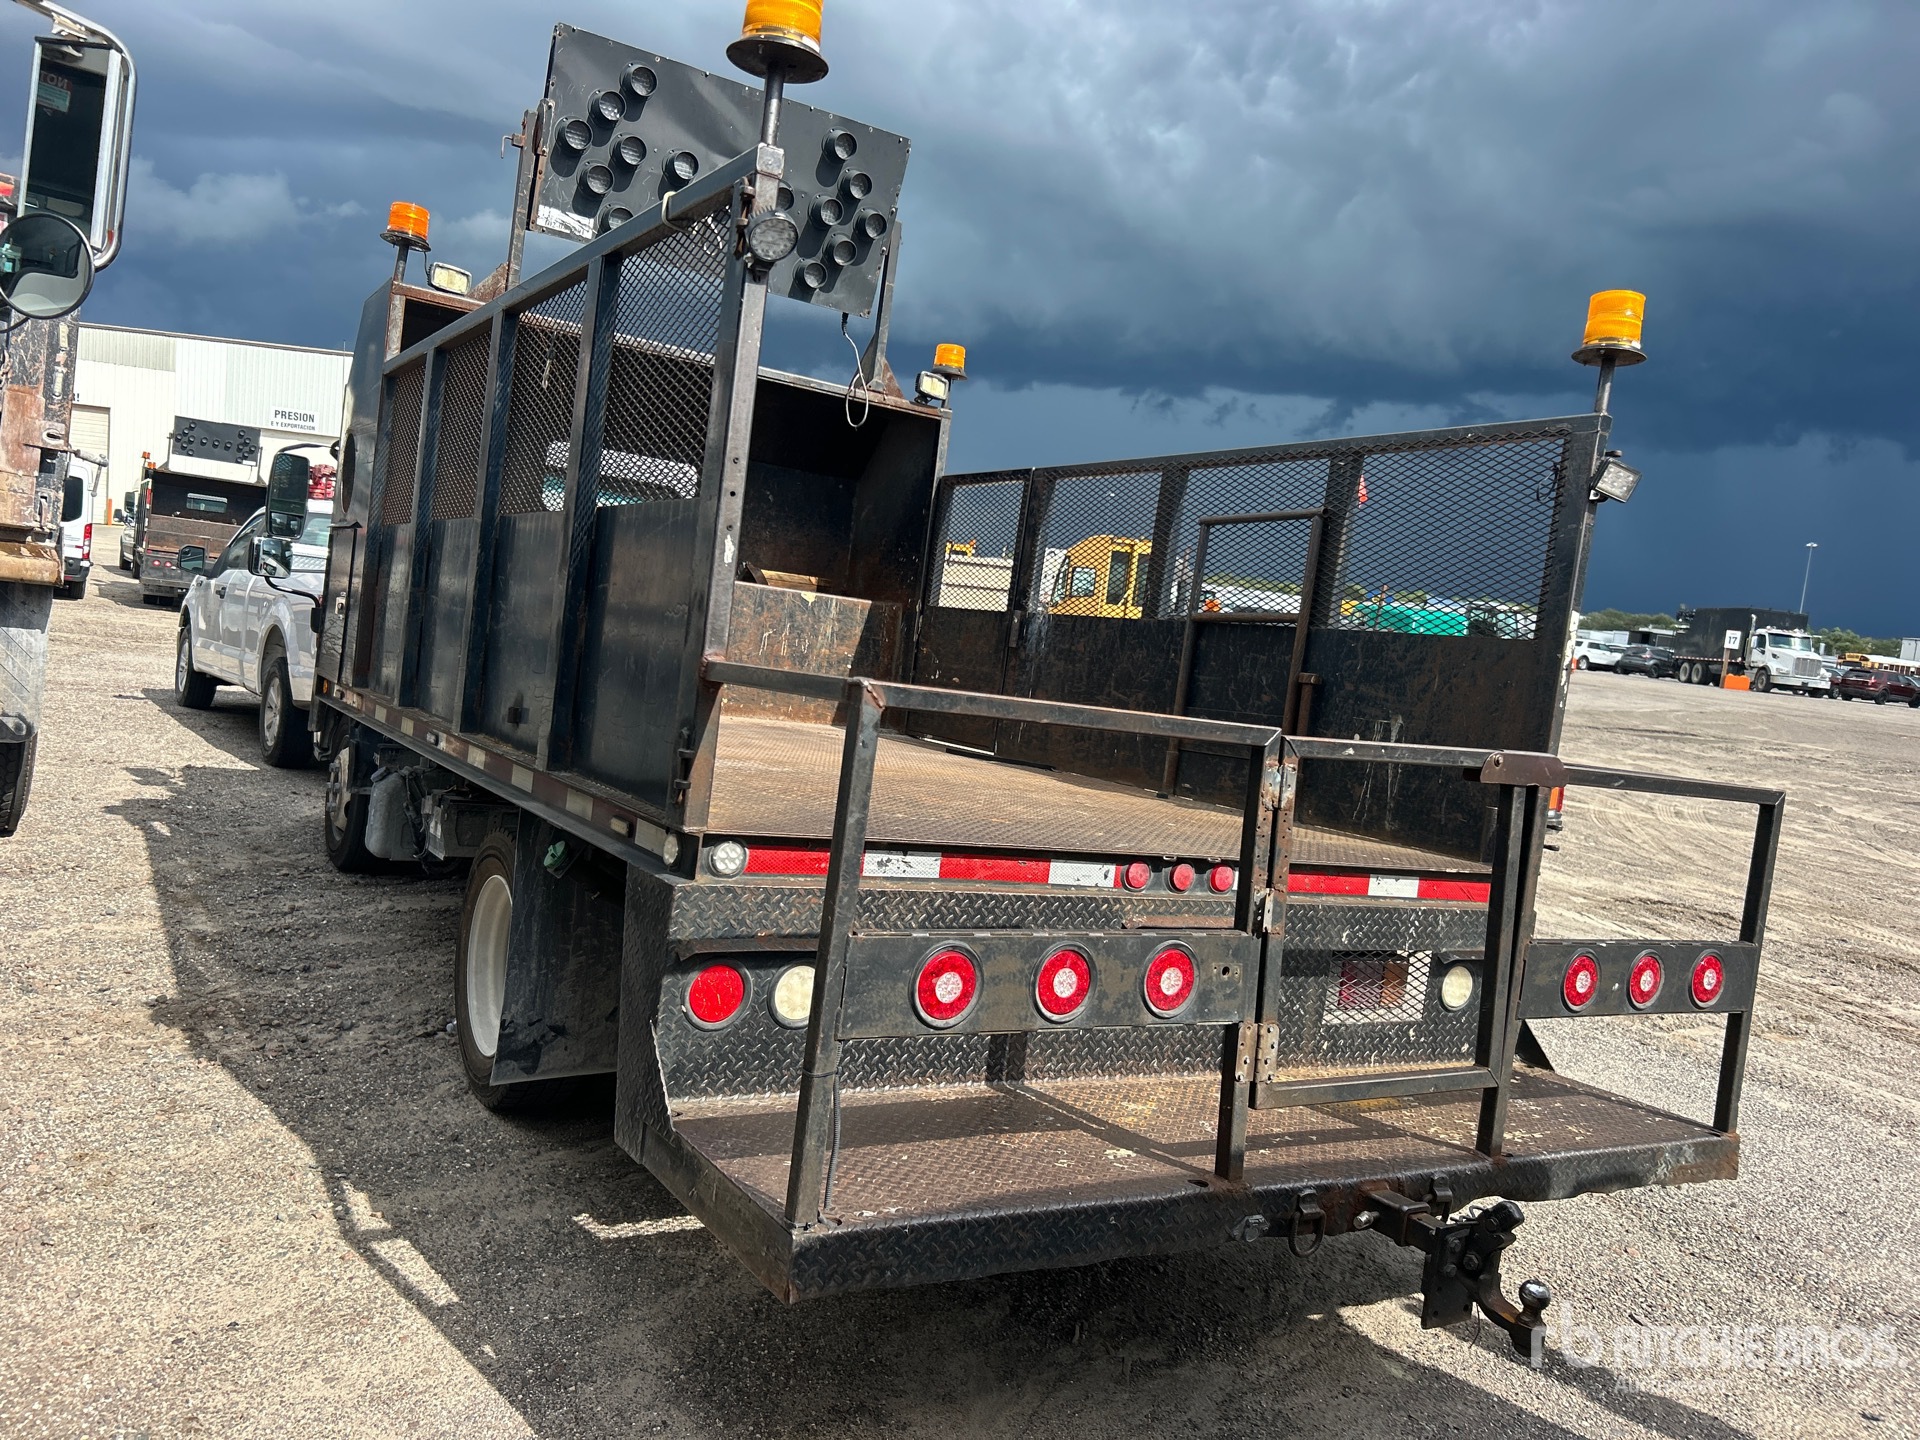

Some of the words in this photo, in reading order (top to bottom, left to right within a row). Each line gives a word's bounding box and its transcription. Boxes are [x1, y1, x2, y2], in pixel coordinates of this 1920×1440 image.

[274, 409, 315, 423] PRESION
[280, 422, 316, 430] EXPORTACION
[1728, 636, 1738, 645] 17
